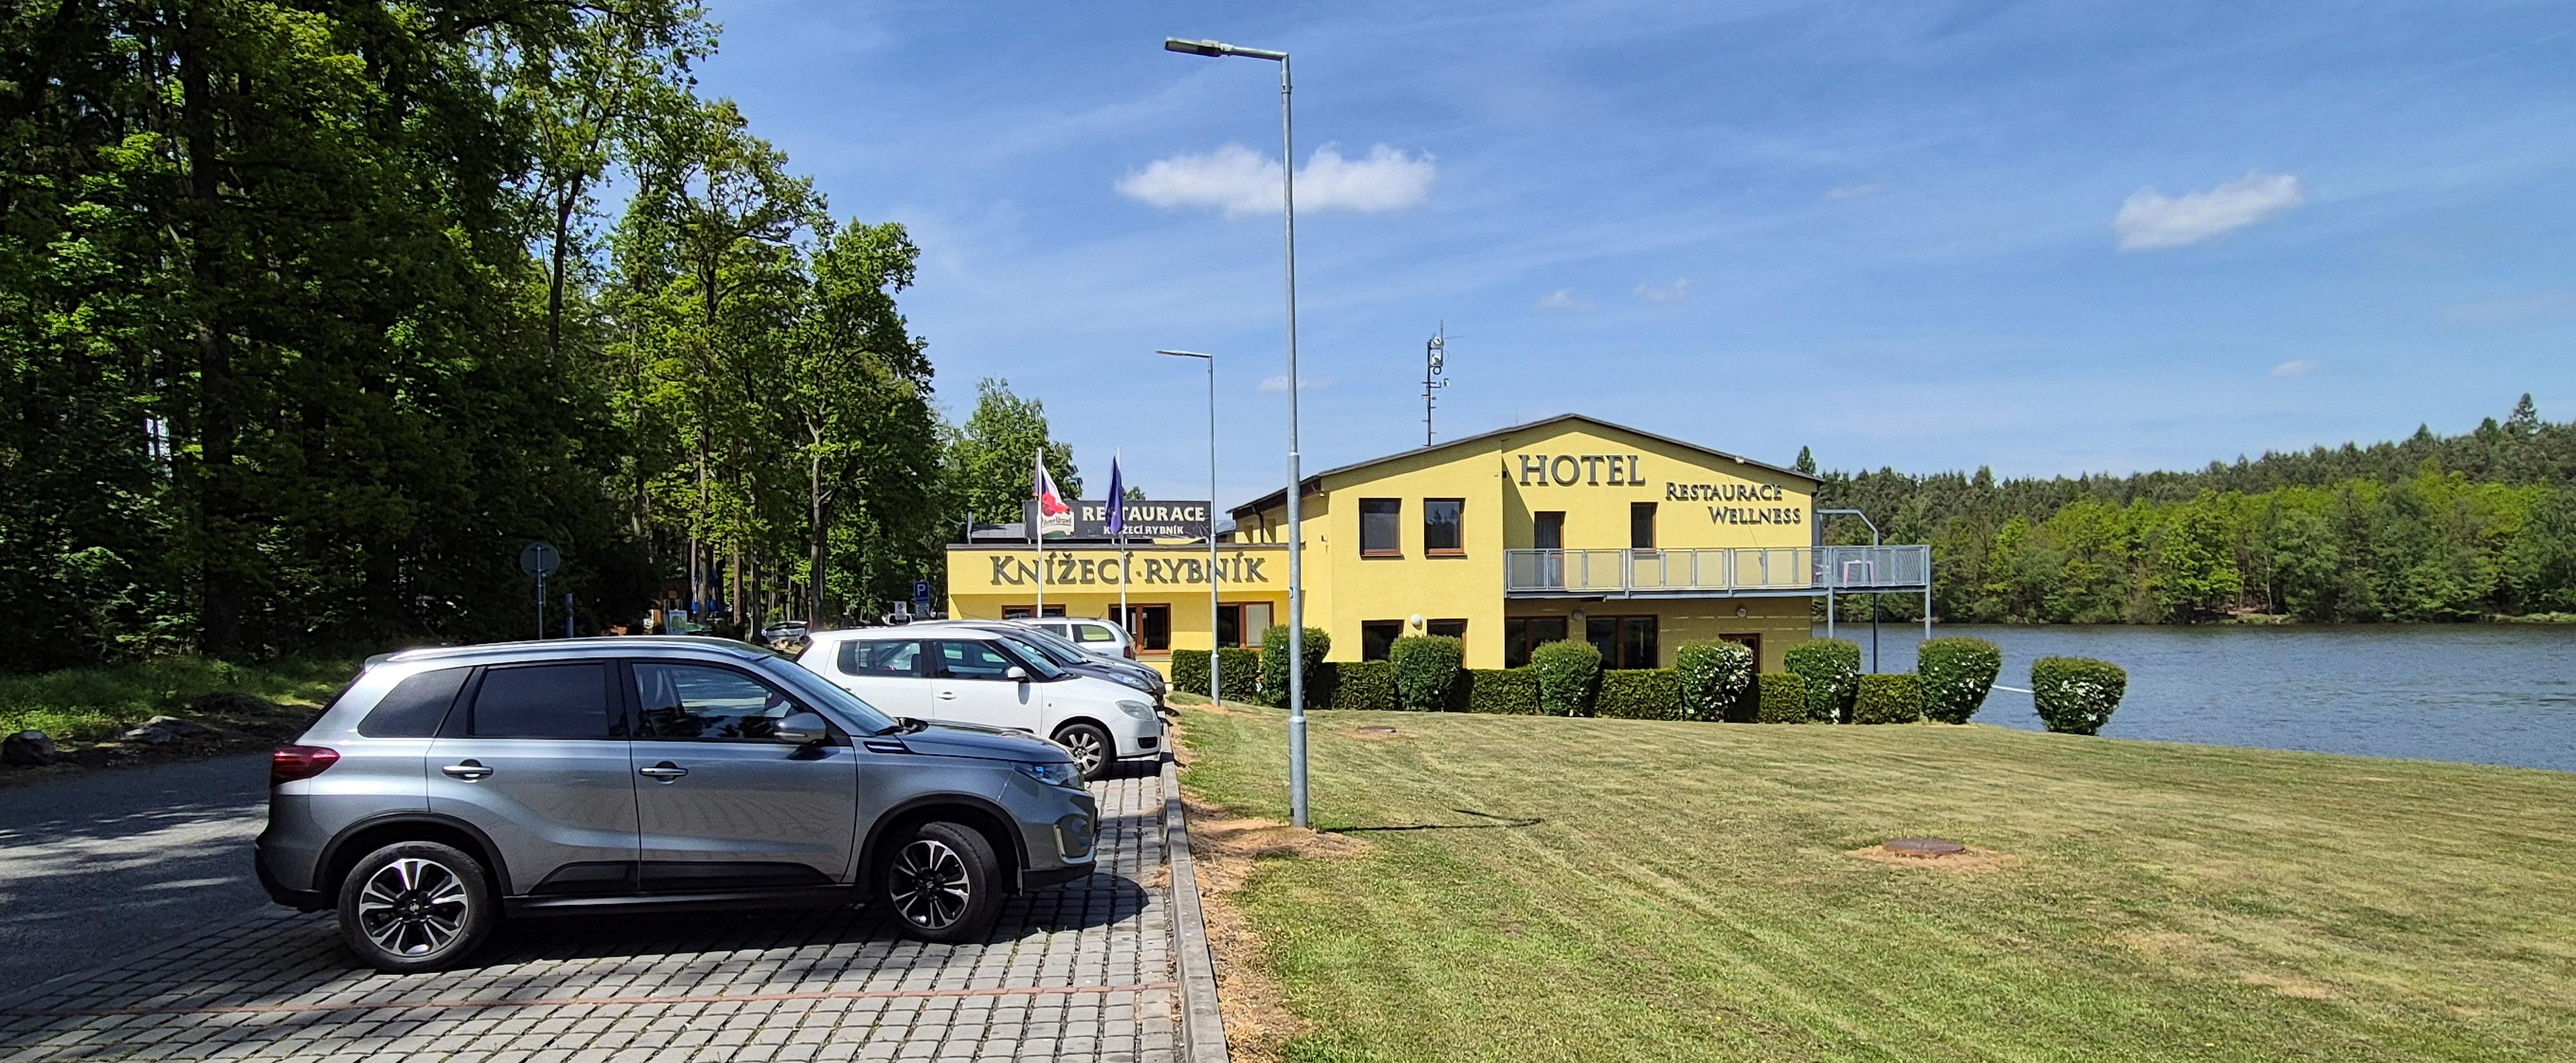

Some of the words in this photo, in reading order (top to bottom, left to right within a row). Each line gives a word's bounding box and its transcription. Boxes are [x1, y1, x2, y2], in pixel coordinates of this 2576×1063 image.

[1518, 455, 1646, 487] HOTEL
[1665, 483, 1783, 502] RESTAURACE
[1082, 506, 1206, 522] RETAURACE
[1707, 506, 1801, 524] WELLNESS
[1103, 524, 1143, 535] KŽECÍ
[1145, 524, 1184, 535] RYBNÍK
[990, 550, 1134, 585] KNÍŽECÍ
[1144, 551, 1269, 584] RYBNÍK
[917, 584, 925, 597] P
